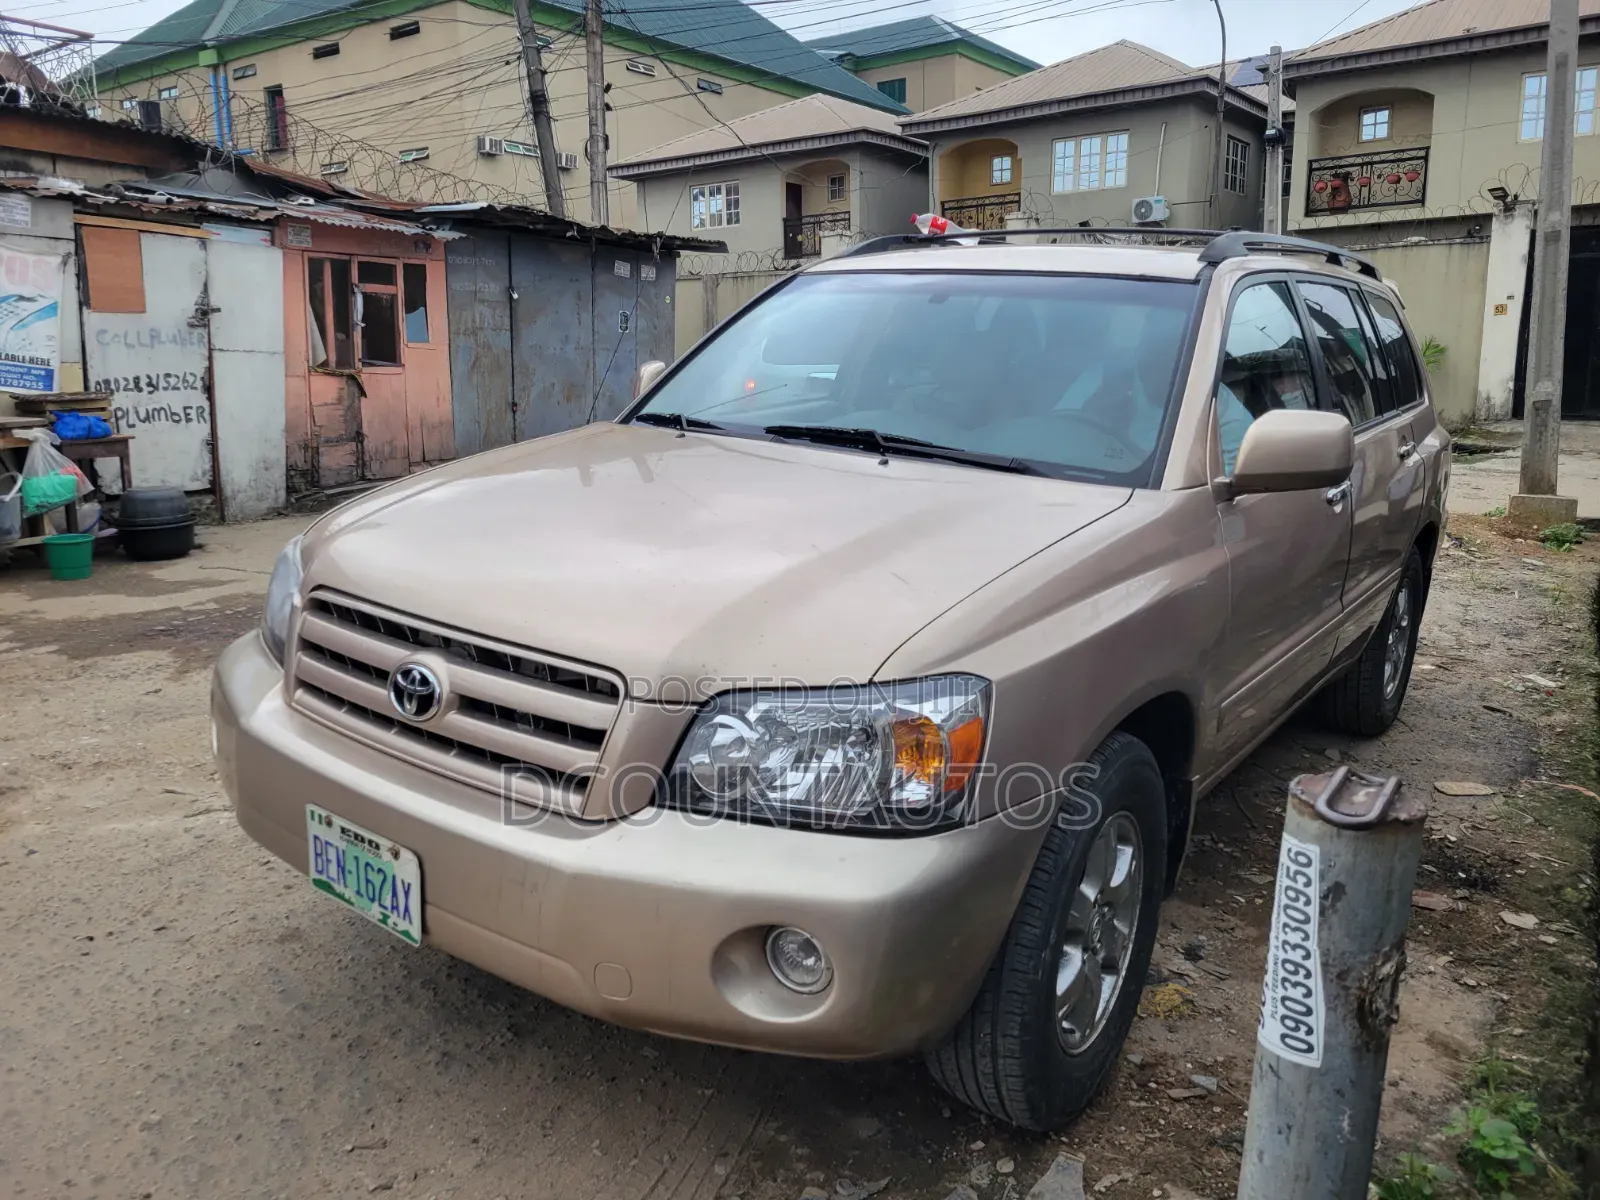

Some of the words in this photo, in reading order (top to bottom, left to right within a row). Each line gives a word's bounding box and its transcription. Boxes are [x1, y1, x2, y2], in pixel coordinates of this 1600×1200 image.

[0, 252, 54, 291] OS
[28, 356, 51, 367] HERE
[313, 834, 413, 926] BEN-162AX
[1280, 847, 1315, 1054] 09039330956
[1271, 953, 1281, 994] FEEDING
[1270, 995, 1279, 1021] PLUS
